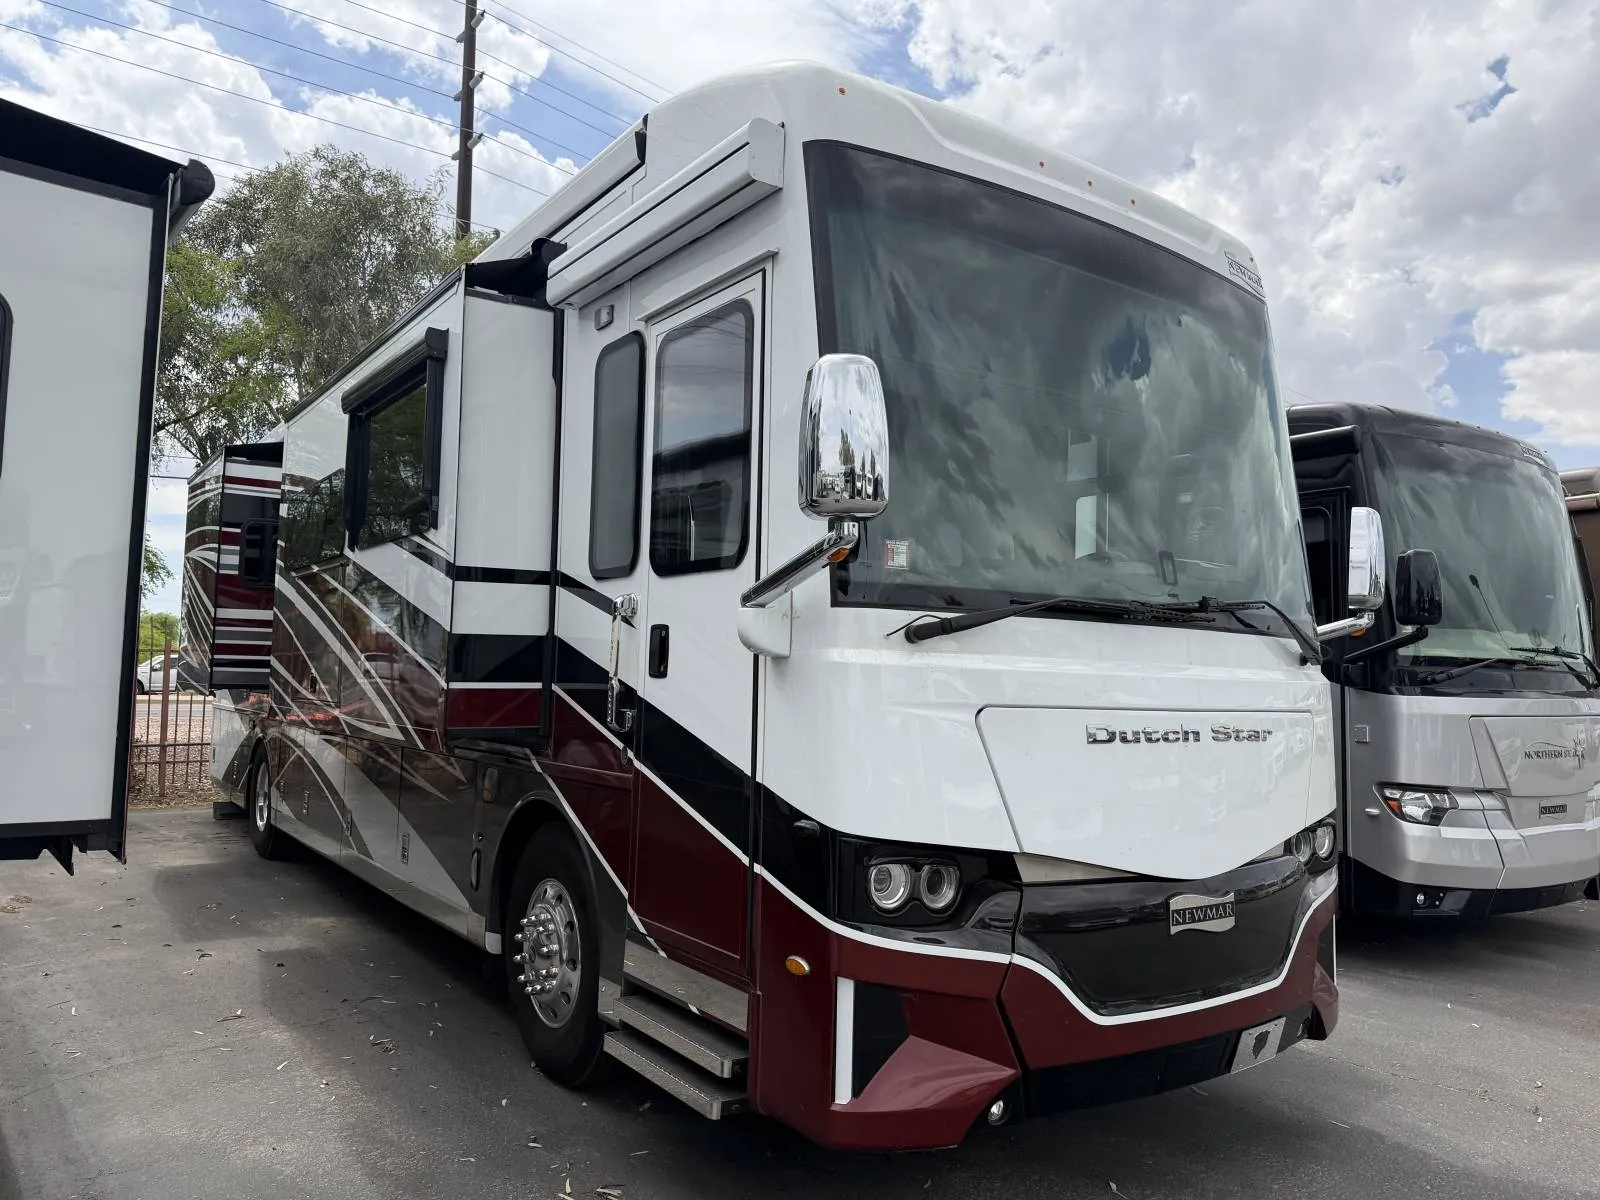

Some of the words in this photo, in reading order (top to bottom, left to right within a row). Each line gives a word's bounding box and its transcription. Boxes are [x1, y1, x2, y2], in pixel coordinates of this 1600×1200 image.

[1085, 723, 1201, 745] Dutch
[1210, 722, 1273, 743] Star
[1524, 749, 1563, 760] NORTHERN
[1172, 903, 1235, 926] NEWMAR
